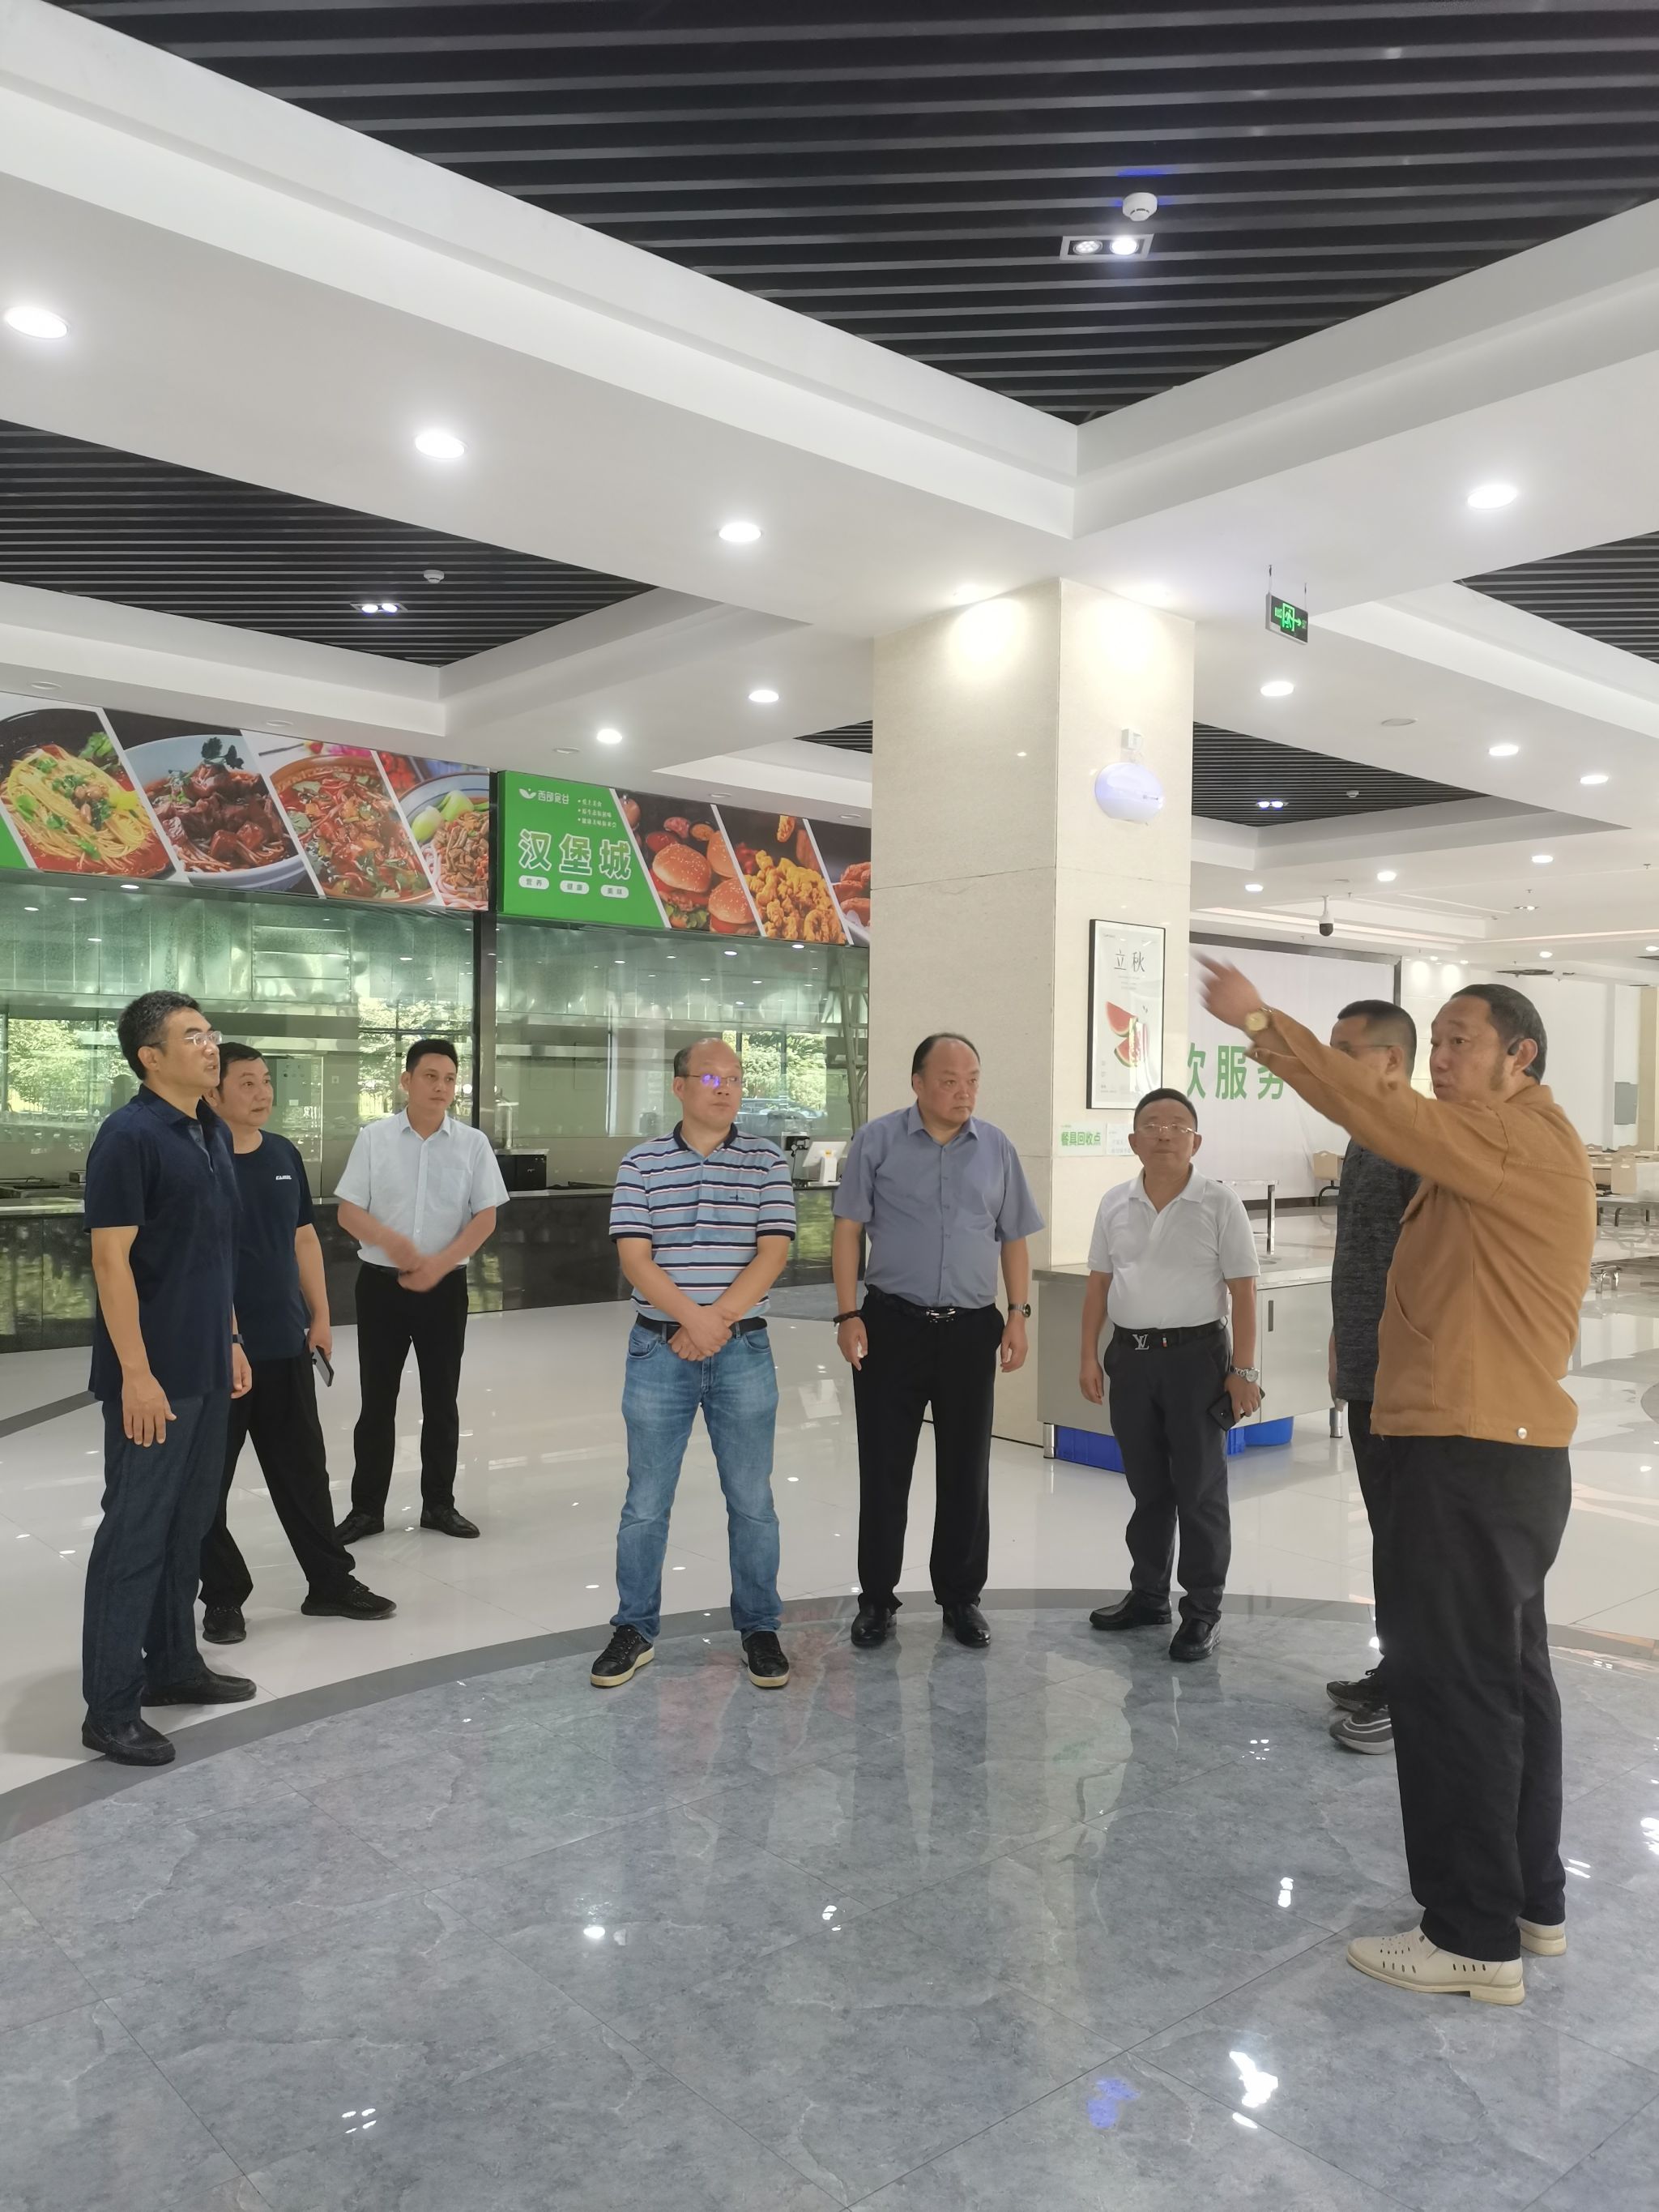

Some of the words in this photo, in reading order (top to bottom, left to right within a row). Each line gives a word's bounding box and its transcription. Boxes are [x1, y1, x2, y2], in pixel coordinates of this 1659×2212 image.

[518, 828, 632, 880] 汉堡城
[1114, 948, 1145, 972] 立秋
[1061, 1131, 1102, 1147] 餐具回收点
